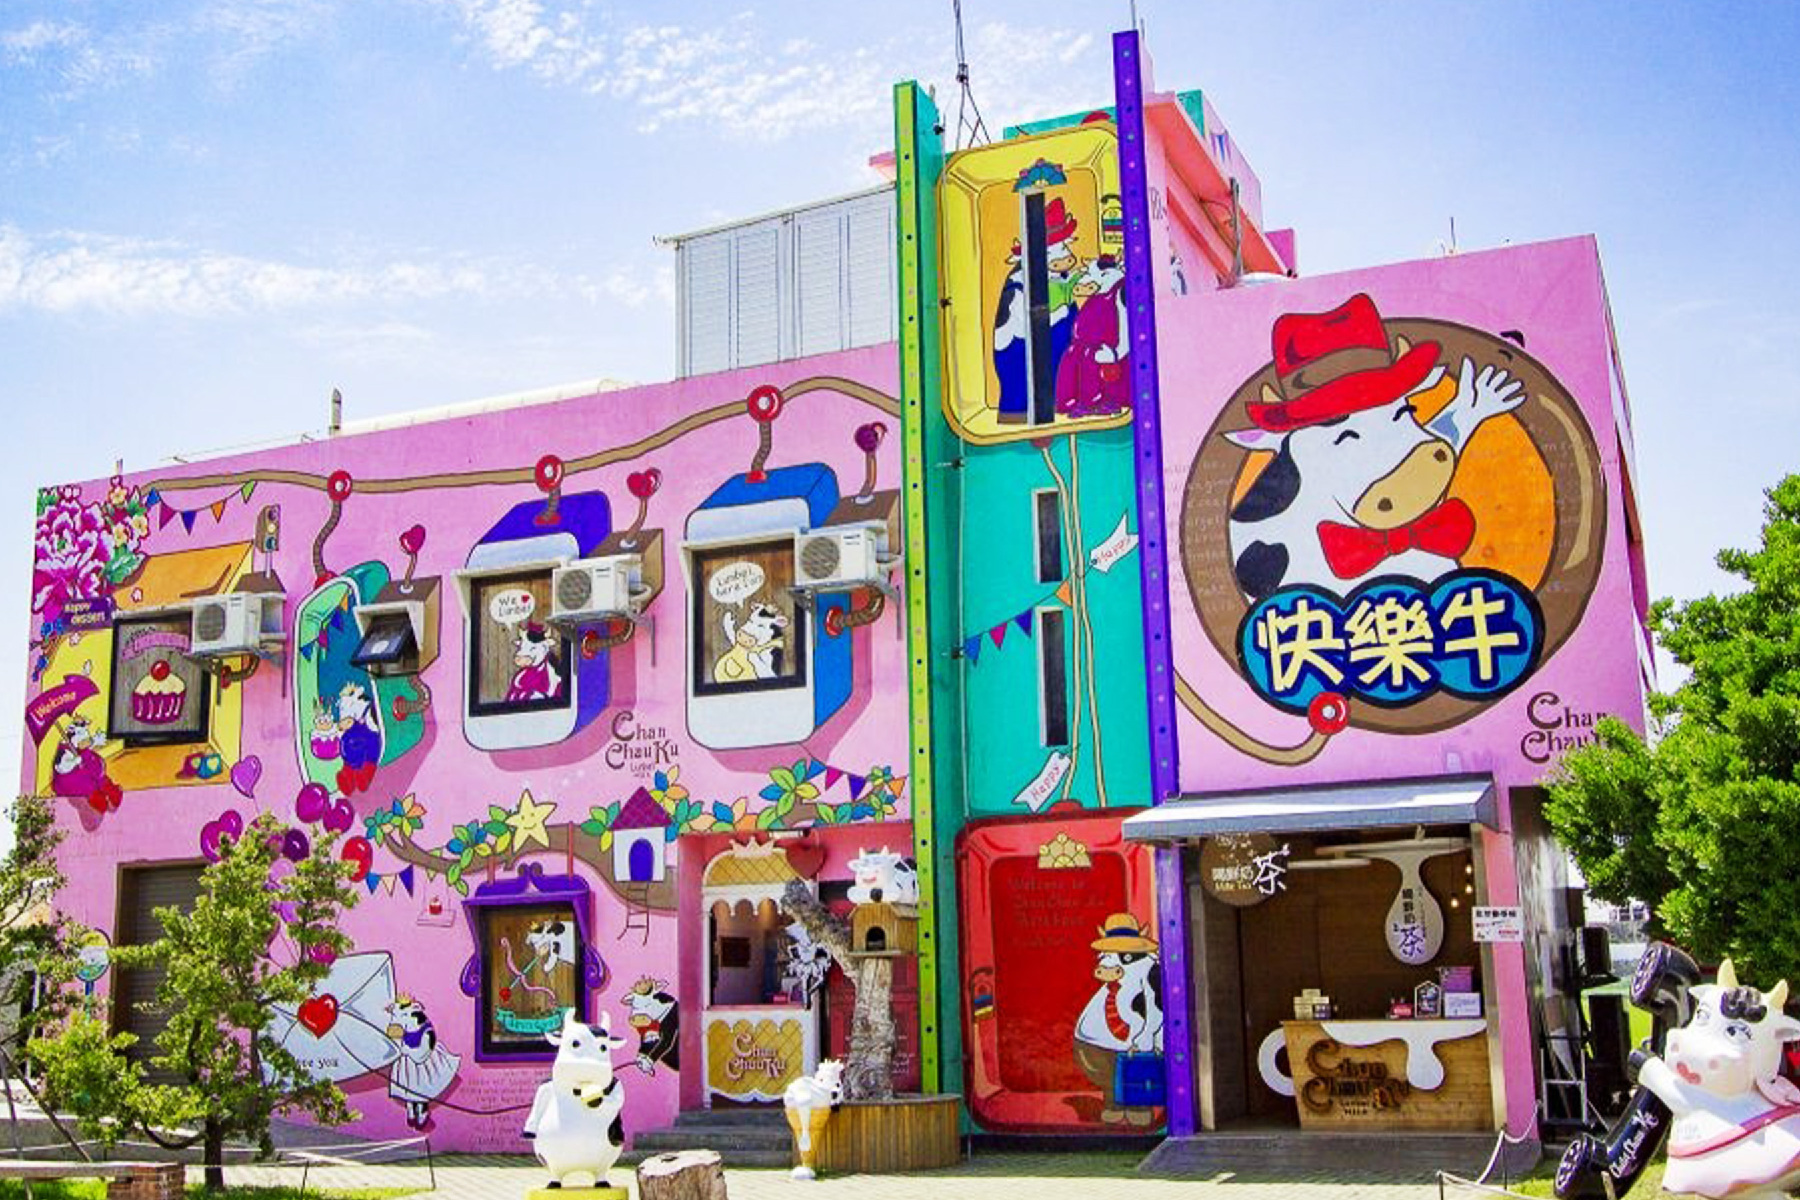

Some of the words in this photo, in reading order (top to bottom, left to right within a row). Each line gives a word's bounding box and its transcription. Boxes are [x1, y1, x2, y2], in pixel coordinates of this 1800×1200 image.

[1257, 587, 1519, 692] 快樂牛
[34, 691, 77, 719] Welcome
[611, 710, 666, 742] Chan
[1029, 765, 1061, 802] Happy
[732, 1032, 778, 1058] Chan
[318, 1058, 338, 1070] you
